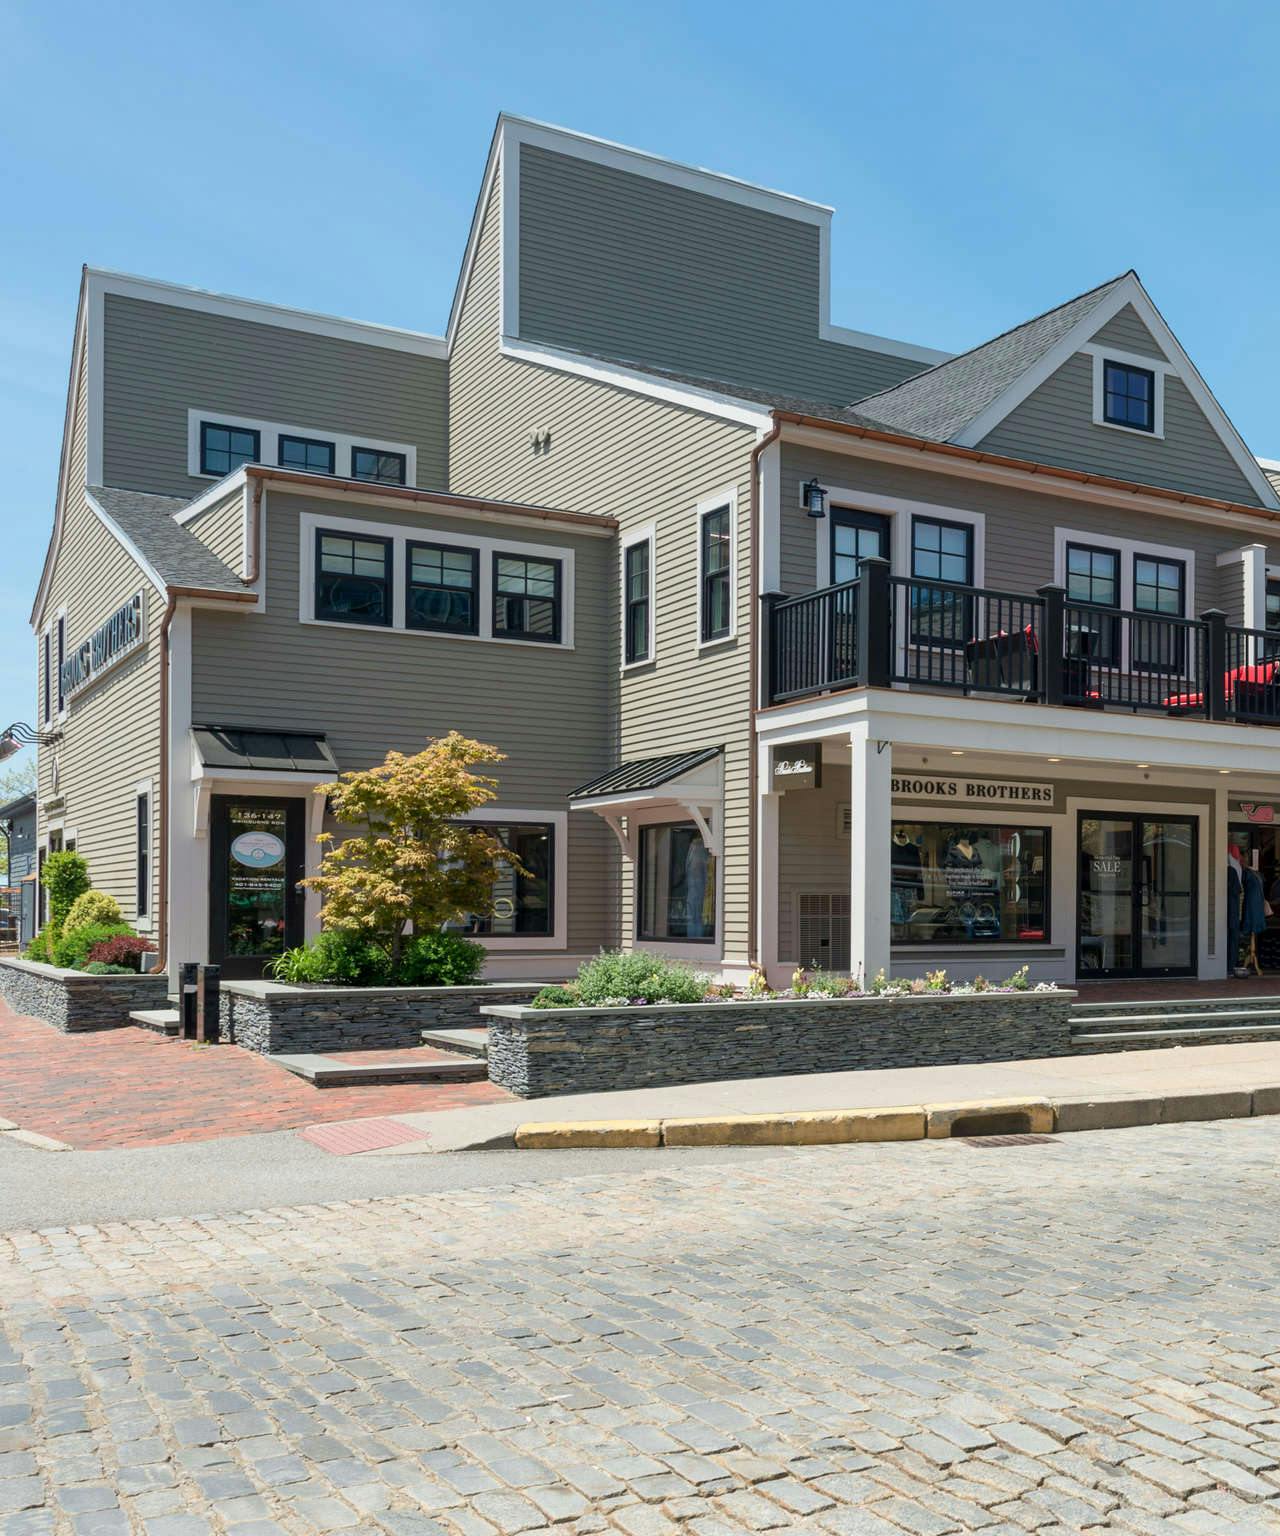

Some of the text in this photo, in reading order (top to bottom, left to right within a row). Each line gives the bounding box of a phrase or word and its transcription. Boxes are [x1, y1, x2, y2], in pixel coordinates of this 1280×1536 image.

[92, 595, 141, 672] BROTHERS
[891, 779, 1052, 801] BROOKS BROTHERS
[1094, 860, 1121, 873] SALE
